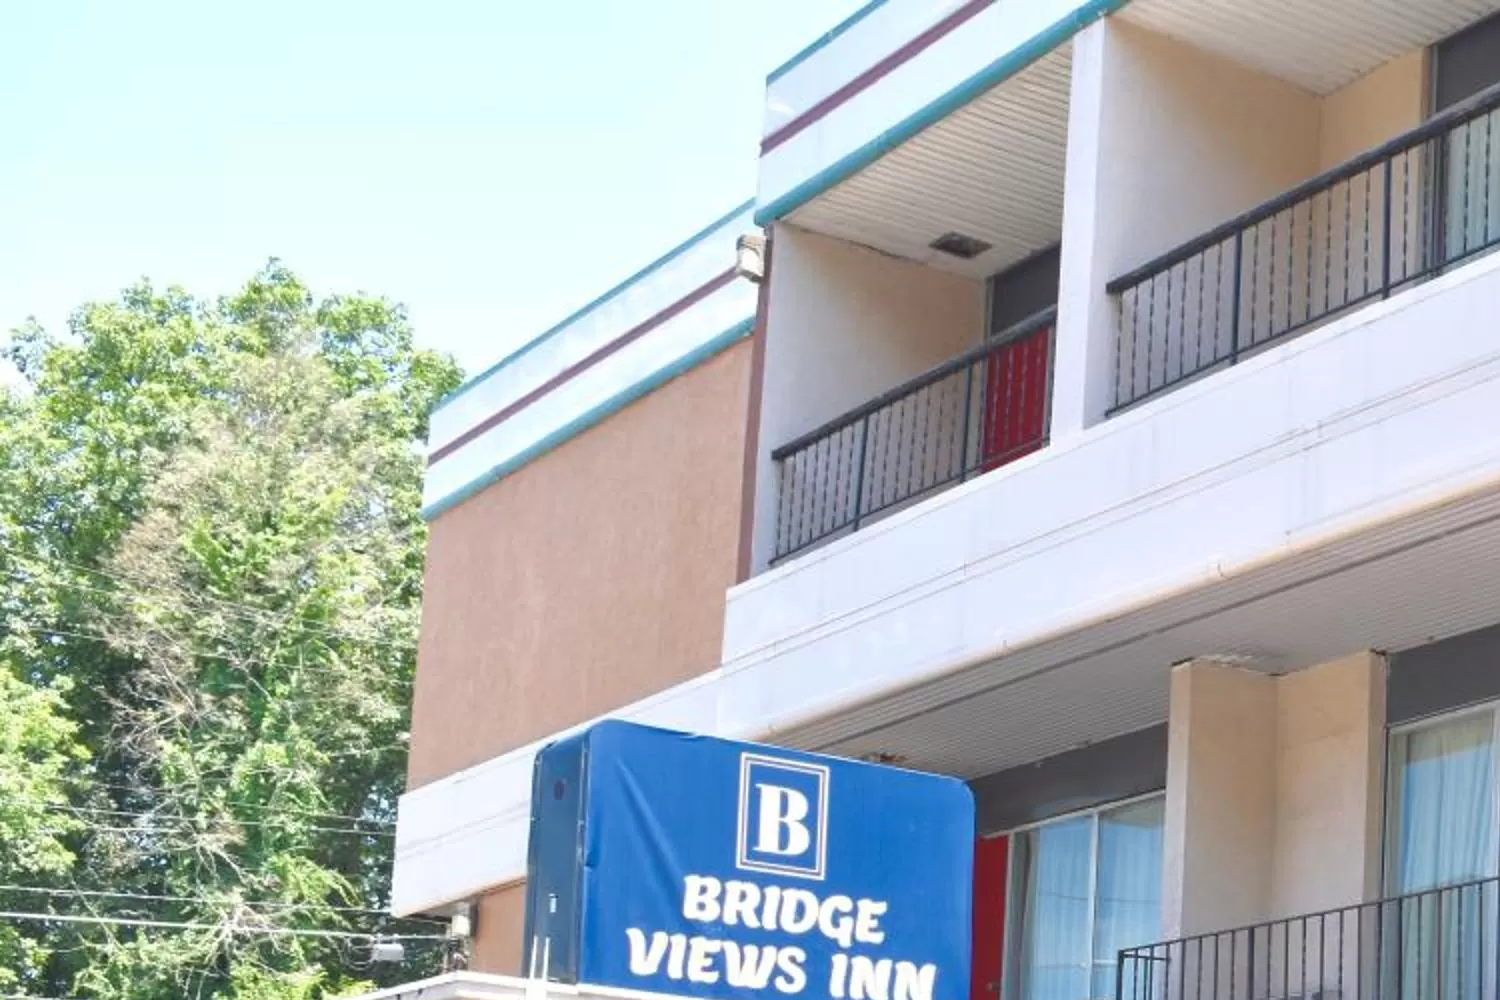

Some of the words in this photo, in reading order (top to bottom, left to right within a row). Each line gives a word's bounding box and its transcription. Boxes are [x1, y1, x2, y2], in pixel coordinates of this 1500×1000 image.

[753, 783, 810, 856] B
[682, 874, 888, 948] BRIDGE
[625, 927, 807, 994] VIEWS
